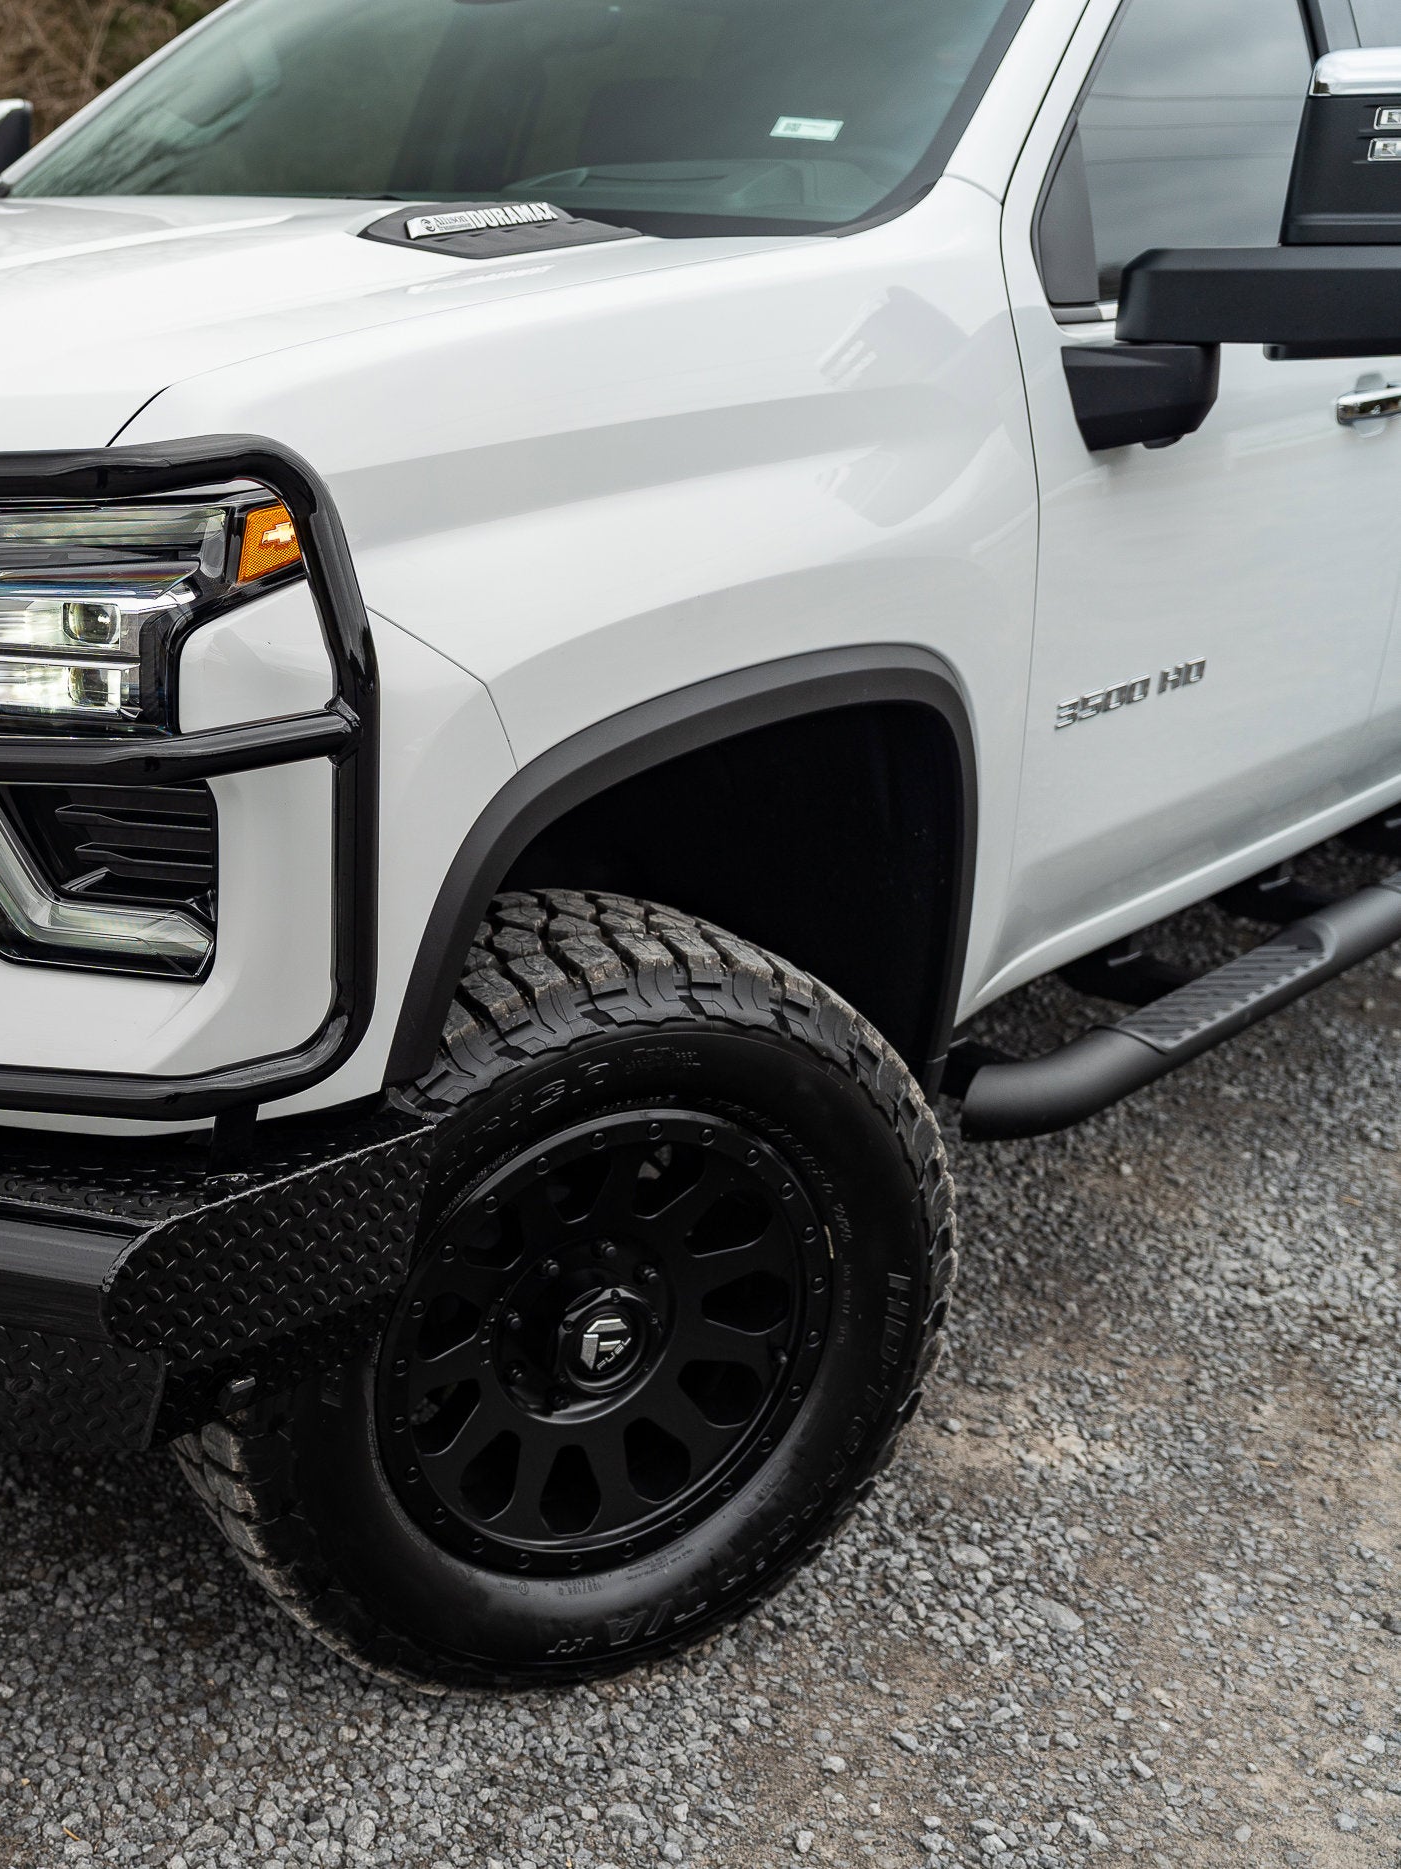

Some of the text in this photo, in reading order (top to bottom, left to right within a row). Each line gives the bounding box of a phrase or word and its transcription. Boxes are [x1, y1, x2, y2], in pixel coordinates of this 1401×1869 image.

[470, 201, 559, 229] DURAMAX
[1054, 656, 1207, 730] 3500 HD
[596, 1337, 632, 1371] FUEL
